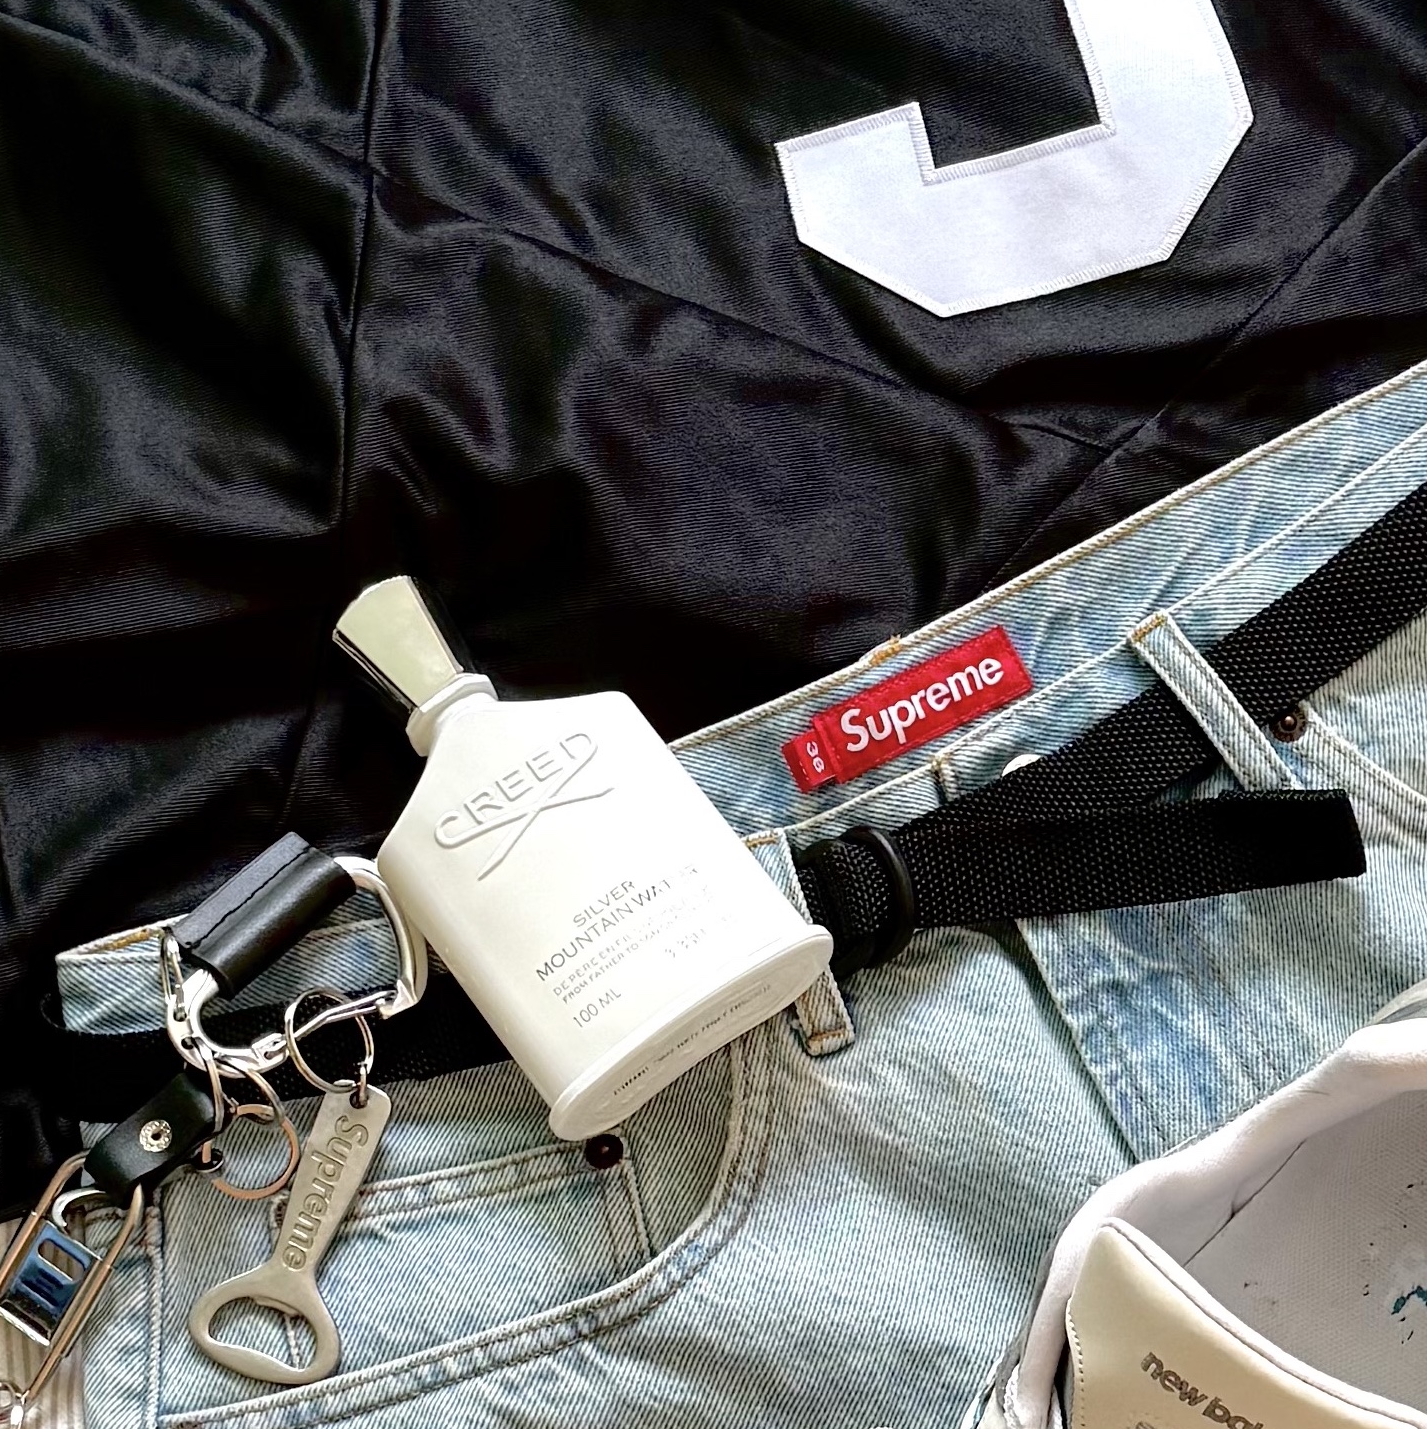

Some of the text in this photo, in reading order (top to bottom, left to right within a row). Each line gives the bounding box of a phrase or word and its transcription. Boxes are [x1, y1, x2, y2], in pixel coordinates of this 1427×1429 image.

[840, 658, 1004, 752] Supreme
[434, 733, 604, 857] CREED
[535, 903, 634, 981] MOUNTAIN
[631, 865, 698, 907] WAT
[573, 881, 635, 928] SILVER
[573, 988, 622, 1028] 100 ML
[282, 1115, 369, 1272] Supreme
